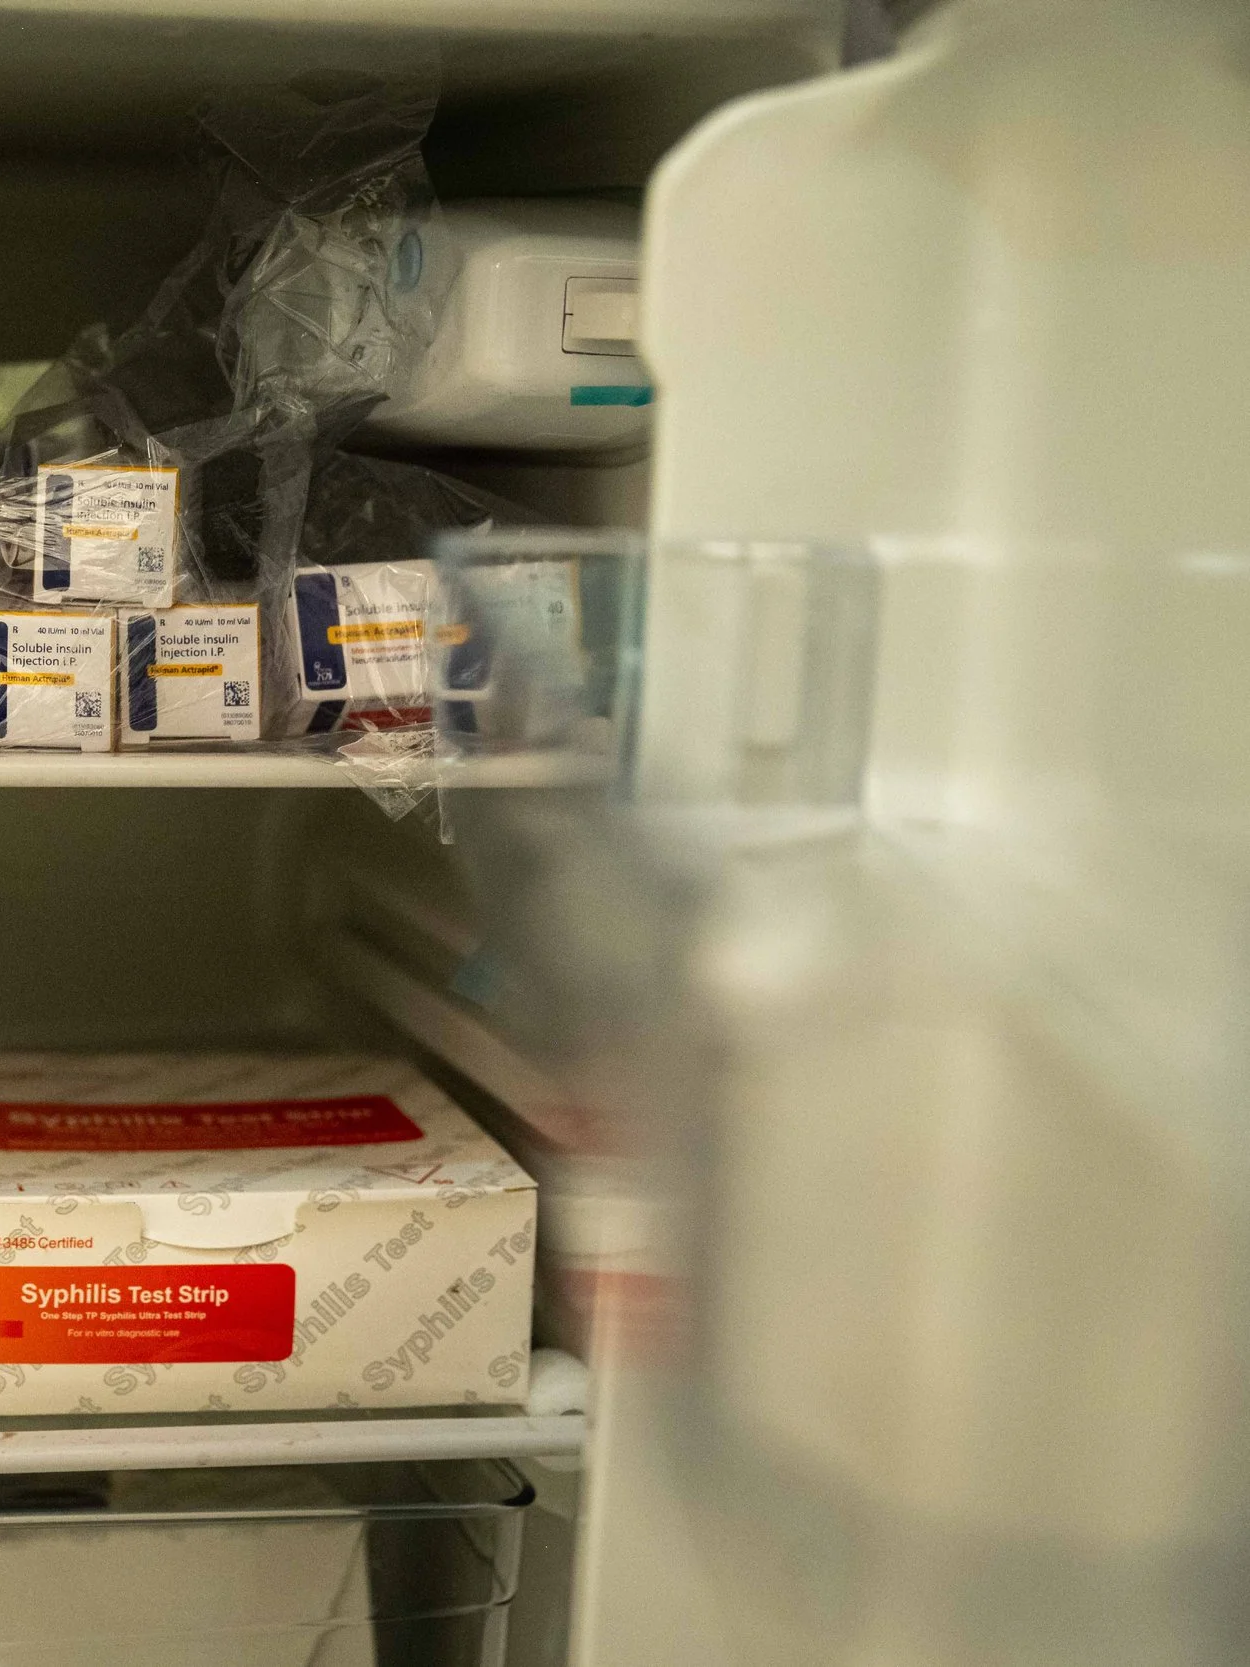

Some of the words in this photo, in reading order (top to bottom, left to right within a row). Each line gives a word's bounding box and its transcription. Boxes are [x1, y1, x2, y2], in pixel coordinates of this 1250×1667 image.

[155, 482, 169, 491] Vial
[120, 499, 156, 509] insulin
[217, 618, 226, 626] 10
[236, 617, 251, 625] Vial
[37, 627, 47, 635] 40
[70, 627, 79, 635] 10
[90, 628, 105, 636] Vial
[160, 635, 200, 645] Soluble
[203, 634, 239, 645] insulin
[12, 642, 53, 653] Soluble
[55, 643, 92, 654] insulin
[160, 648, 207, 659] injection
[210, 647, 225, 657] I.P.
[12, 655, 60, 668] injection
[38, 1235, 94, 1249] Certified
[363, 1210, 434, 1272] Test
[21, 1283, 121, 1308] Syphilis
[128, 1285, 173, 1304] Test
[178, 1285, 229, 1307] Strip
[40, 1312, 60, 1320] One
[62, 1312, 83, 1322] Step
[85, 1312, 98, 1320] TP
[99, 1311, 137, 1322] Syphilis
[138, 1311, 161, 1320] Ultra
[163, 1311, 182, 1320] Test
[184, 1311, 207, 1321] Strip
[67, 1329, 84, 1337] For
[85, 1329, 93, 1337] in
[95, 1329, 114, 1337] vitro
[116, 1329, 161, 1339] diagnostic
[361, 1267, 496, 1391] Syphilis
